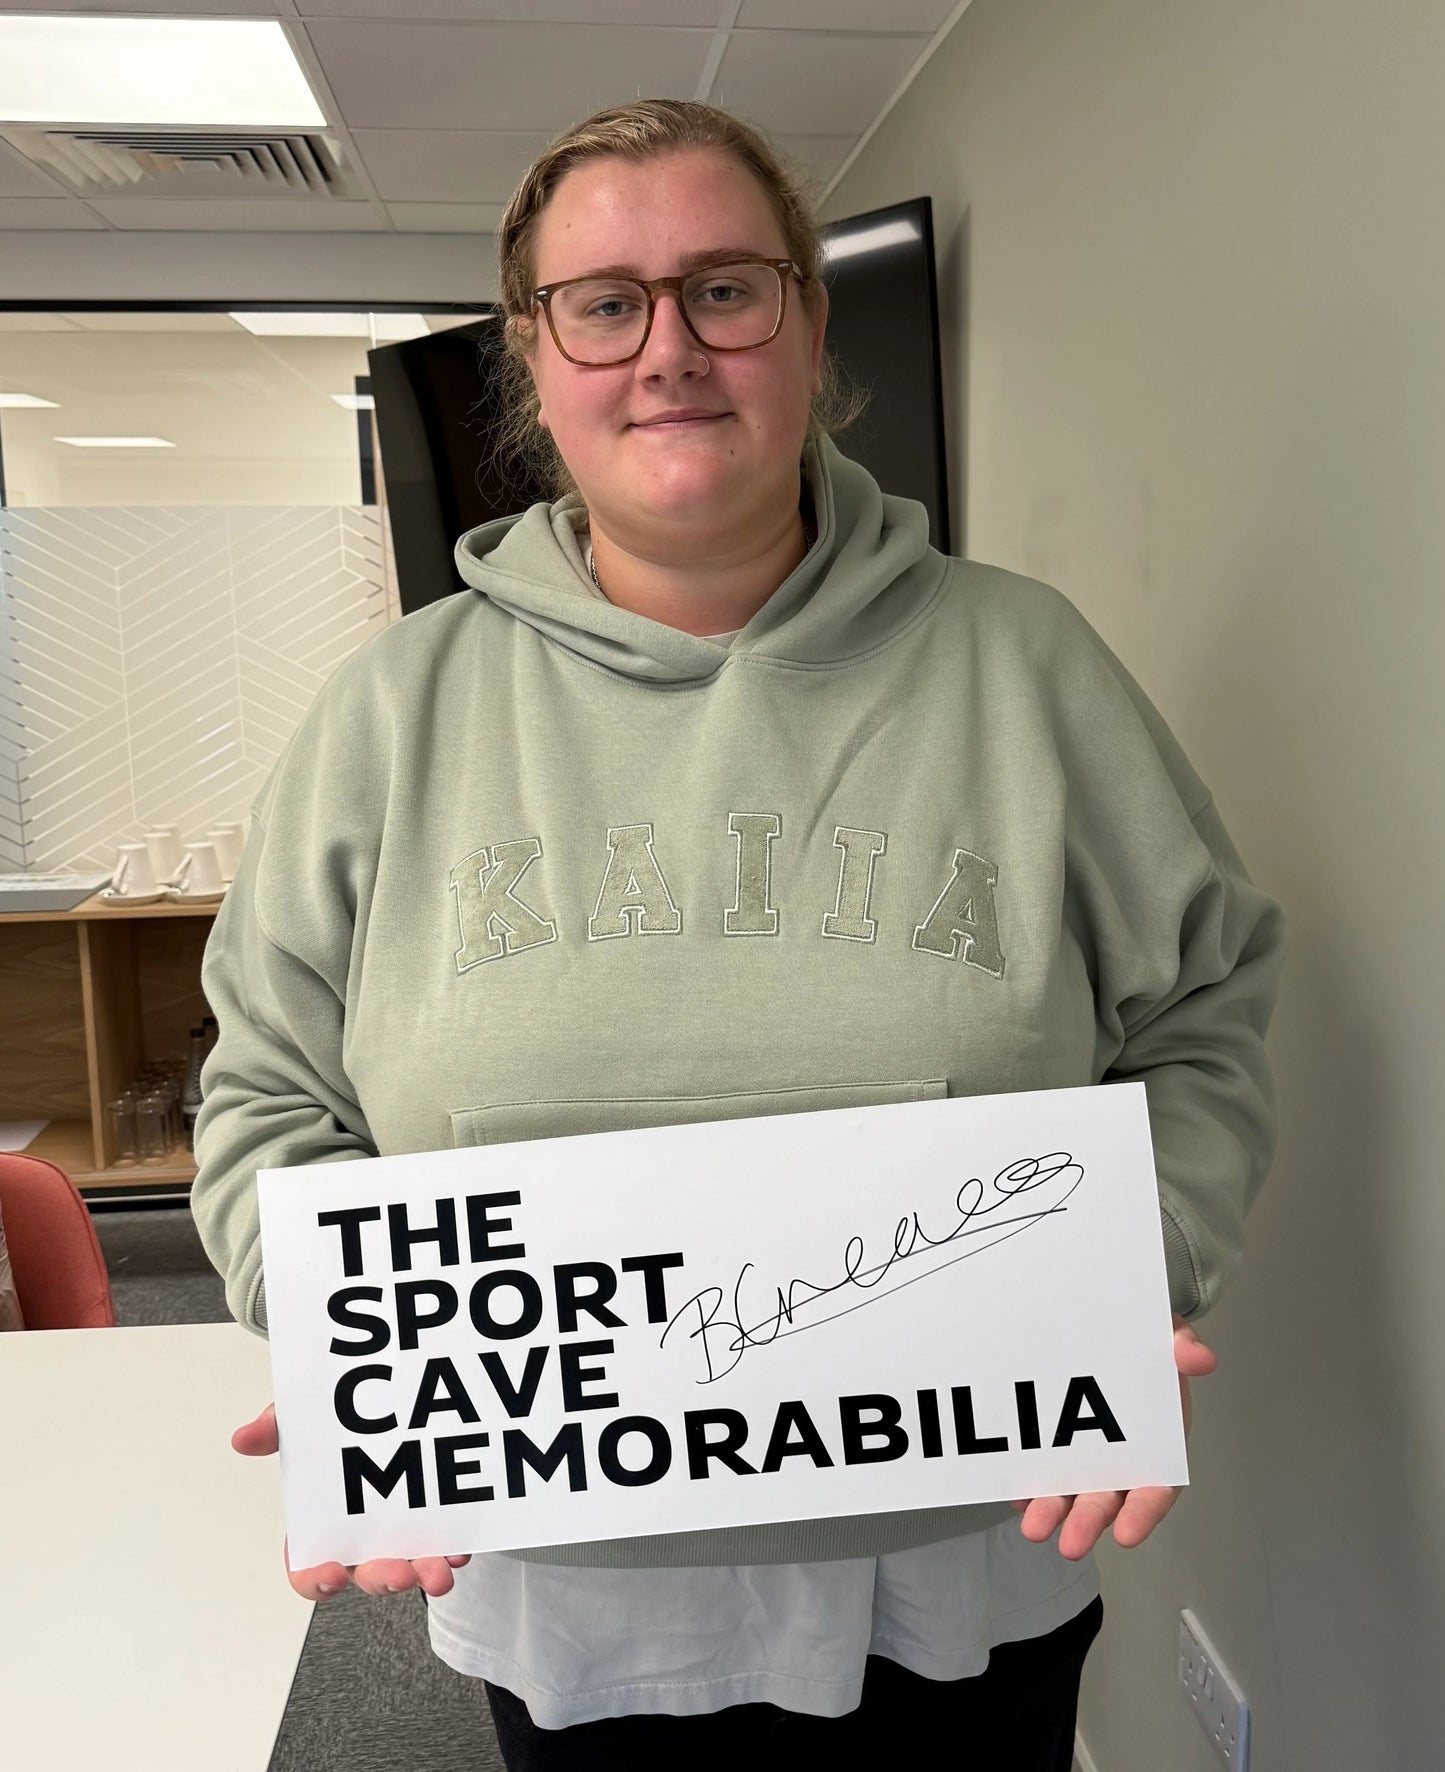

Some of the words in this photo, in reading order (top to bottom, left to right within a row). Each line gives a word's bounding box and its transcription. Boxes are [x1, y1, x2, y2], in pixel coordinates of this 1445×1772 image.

[449, 811, 1006, 980] KAIIA
[317, 1190, 526, 1278] THE
[326, 1251, 685, 1357] SPORT
[333, 1338, 620, 1435] CAVE
[341, 1375, 1127, 1516] MEMORABILIA
